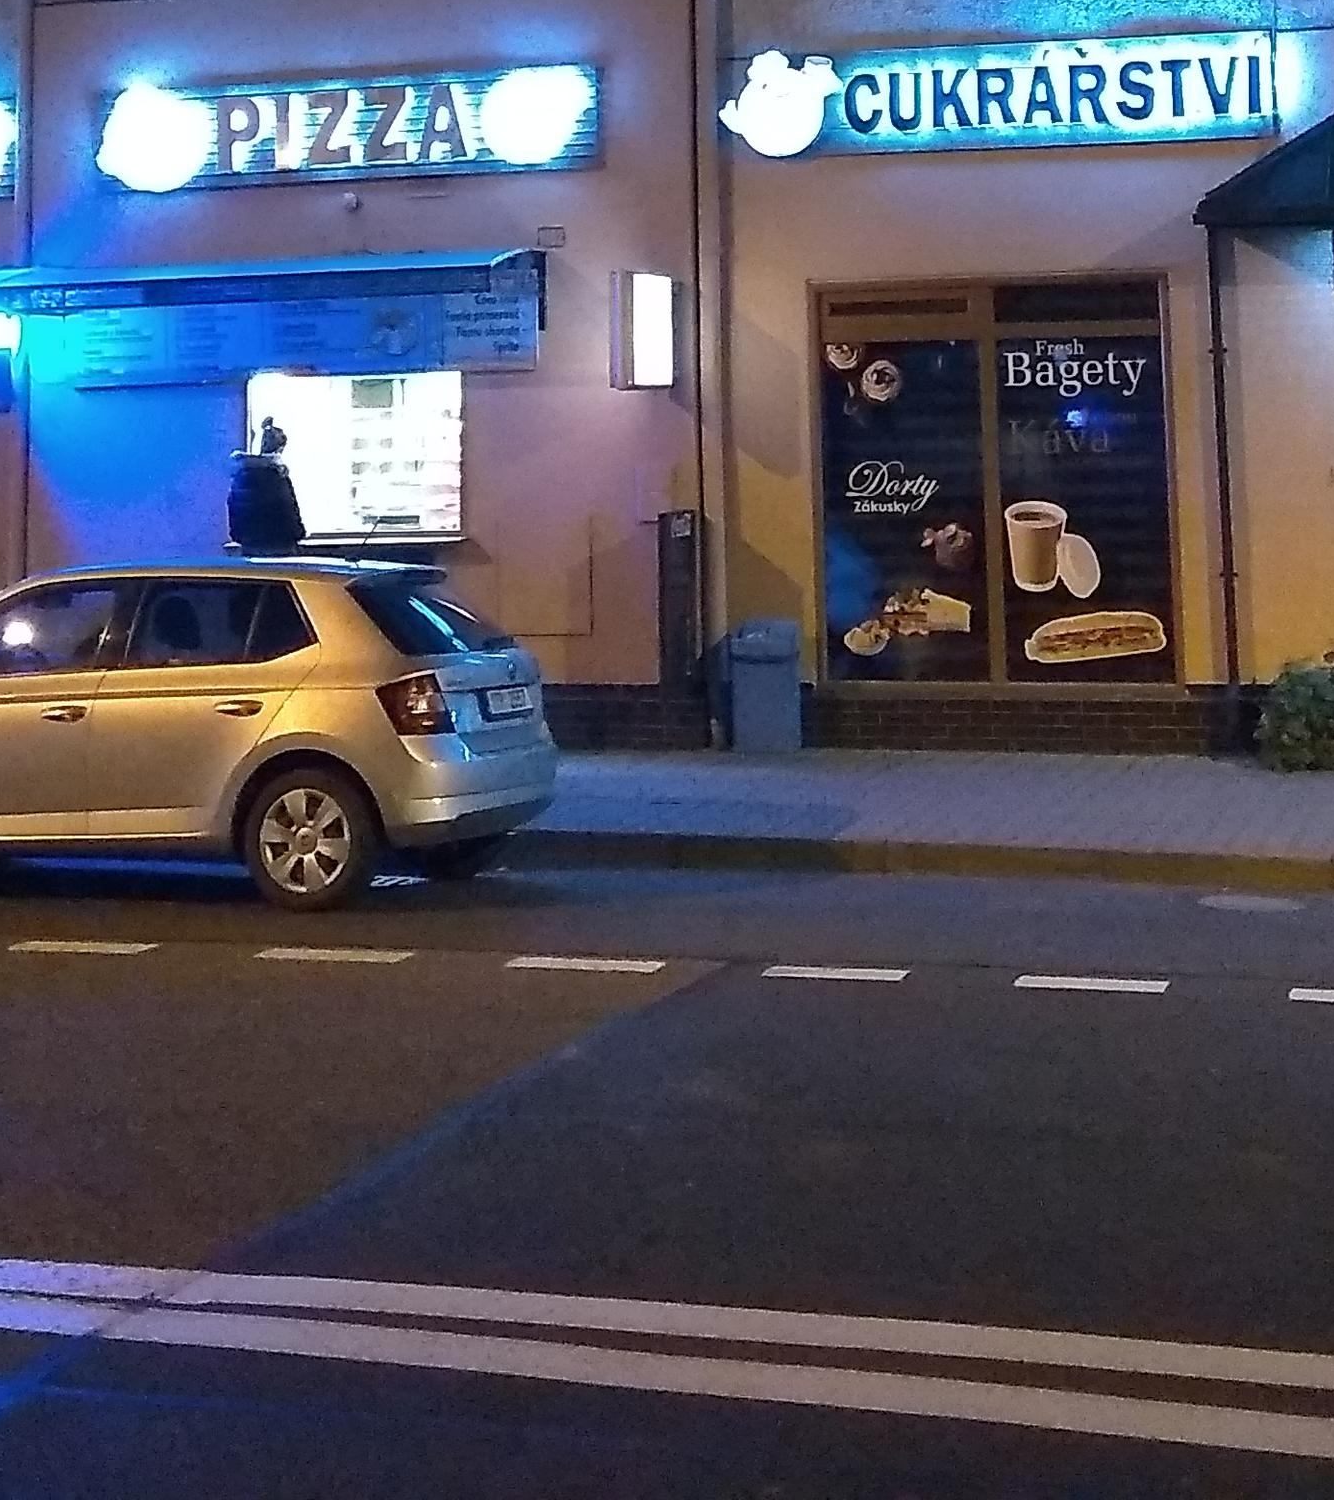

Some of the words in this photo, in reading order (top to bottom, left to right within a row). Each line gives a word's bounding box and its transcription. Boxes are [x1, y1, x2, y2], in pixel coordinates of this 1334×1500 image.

[843, 38, 1264, 135] CUKRÁŘSTVÍ
[216, 83, 468, 173] PIZZA
[1034, 337, 1085, 357] Fresh
[1002, 351, 1147, 398] Bagety
[1008, 418, 1112, 455] Káva
[845, 460, 940, 512] Dorty
[853, 499, 911, 515] Zákusky
